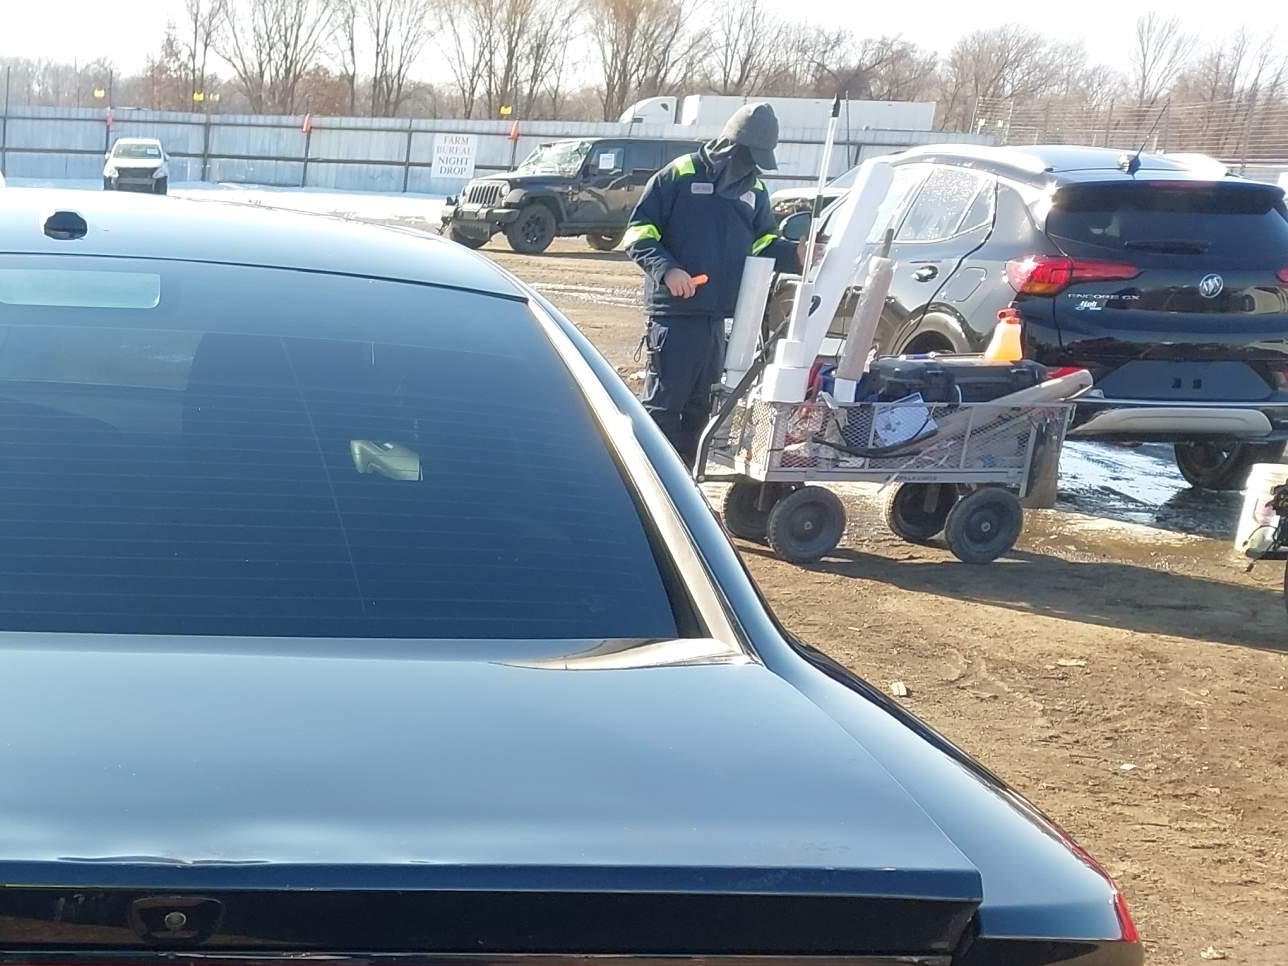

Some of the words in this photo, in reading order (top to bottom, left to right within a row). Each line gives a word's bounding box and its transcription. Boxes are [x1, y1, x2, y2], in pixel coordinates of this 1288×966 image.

[443, 135, 470, 145] FARM
[438, 156, 469, 166] NIGHT
[439, 166, 467, 176] DROP
[1067, 293, 1120, 301] ENCORE
